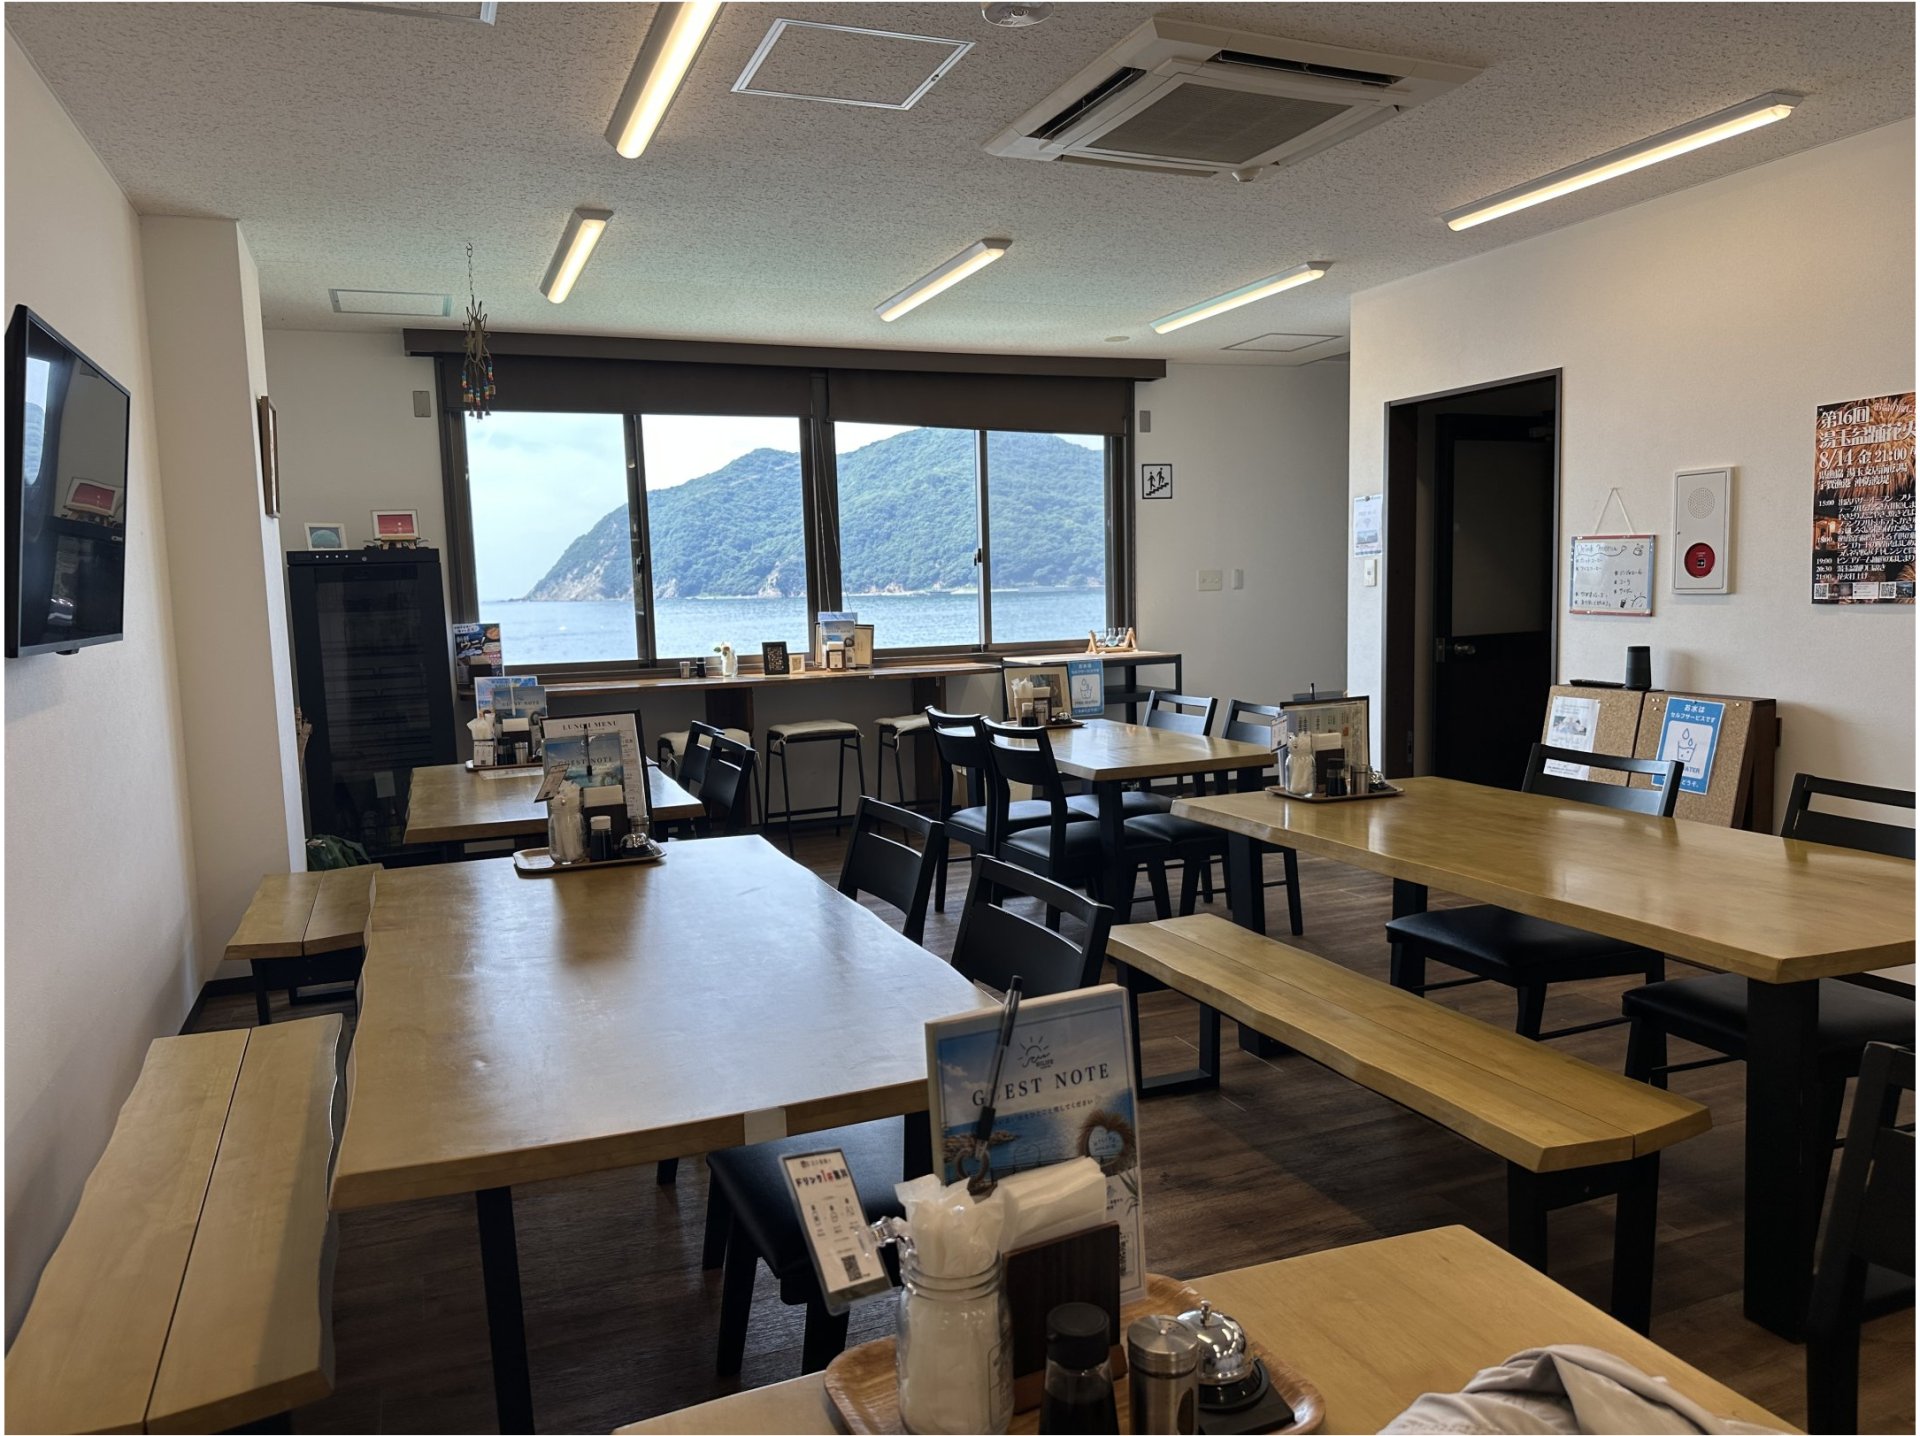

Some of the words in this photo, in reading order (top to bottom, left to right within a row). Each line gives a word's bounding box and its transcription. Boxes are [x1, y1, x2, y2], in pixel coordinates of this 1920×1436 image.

[1819, 406, 1870, 429] 第16回
[1819, 449, 1852, 469] 8/14
[1859, 449, 1872, 464] 金
[1875, 447, 1907, 463] 21:00
[1670, 711, 1716, 723] セルフサービスです
[1684, 704, 1705, 713] お水は
[972, 1077, 1042, 1106] GEST
[1055, 1063, 1109, 1089] NOTE
